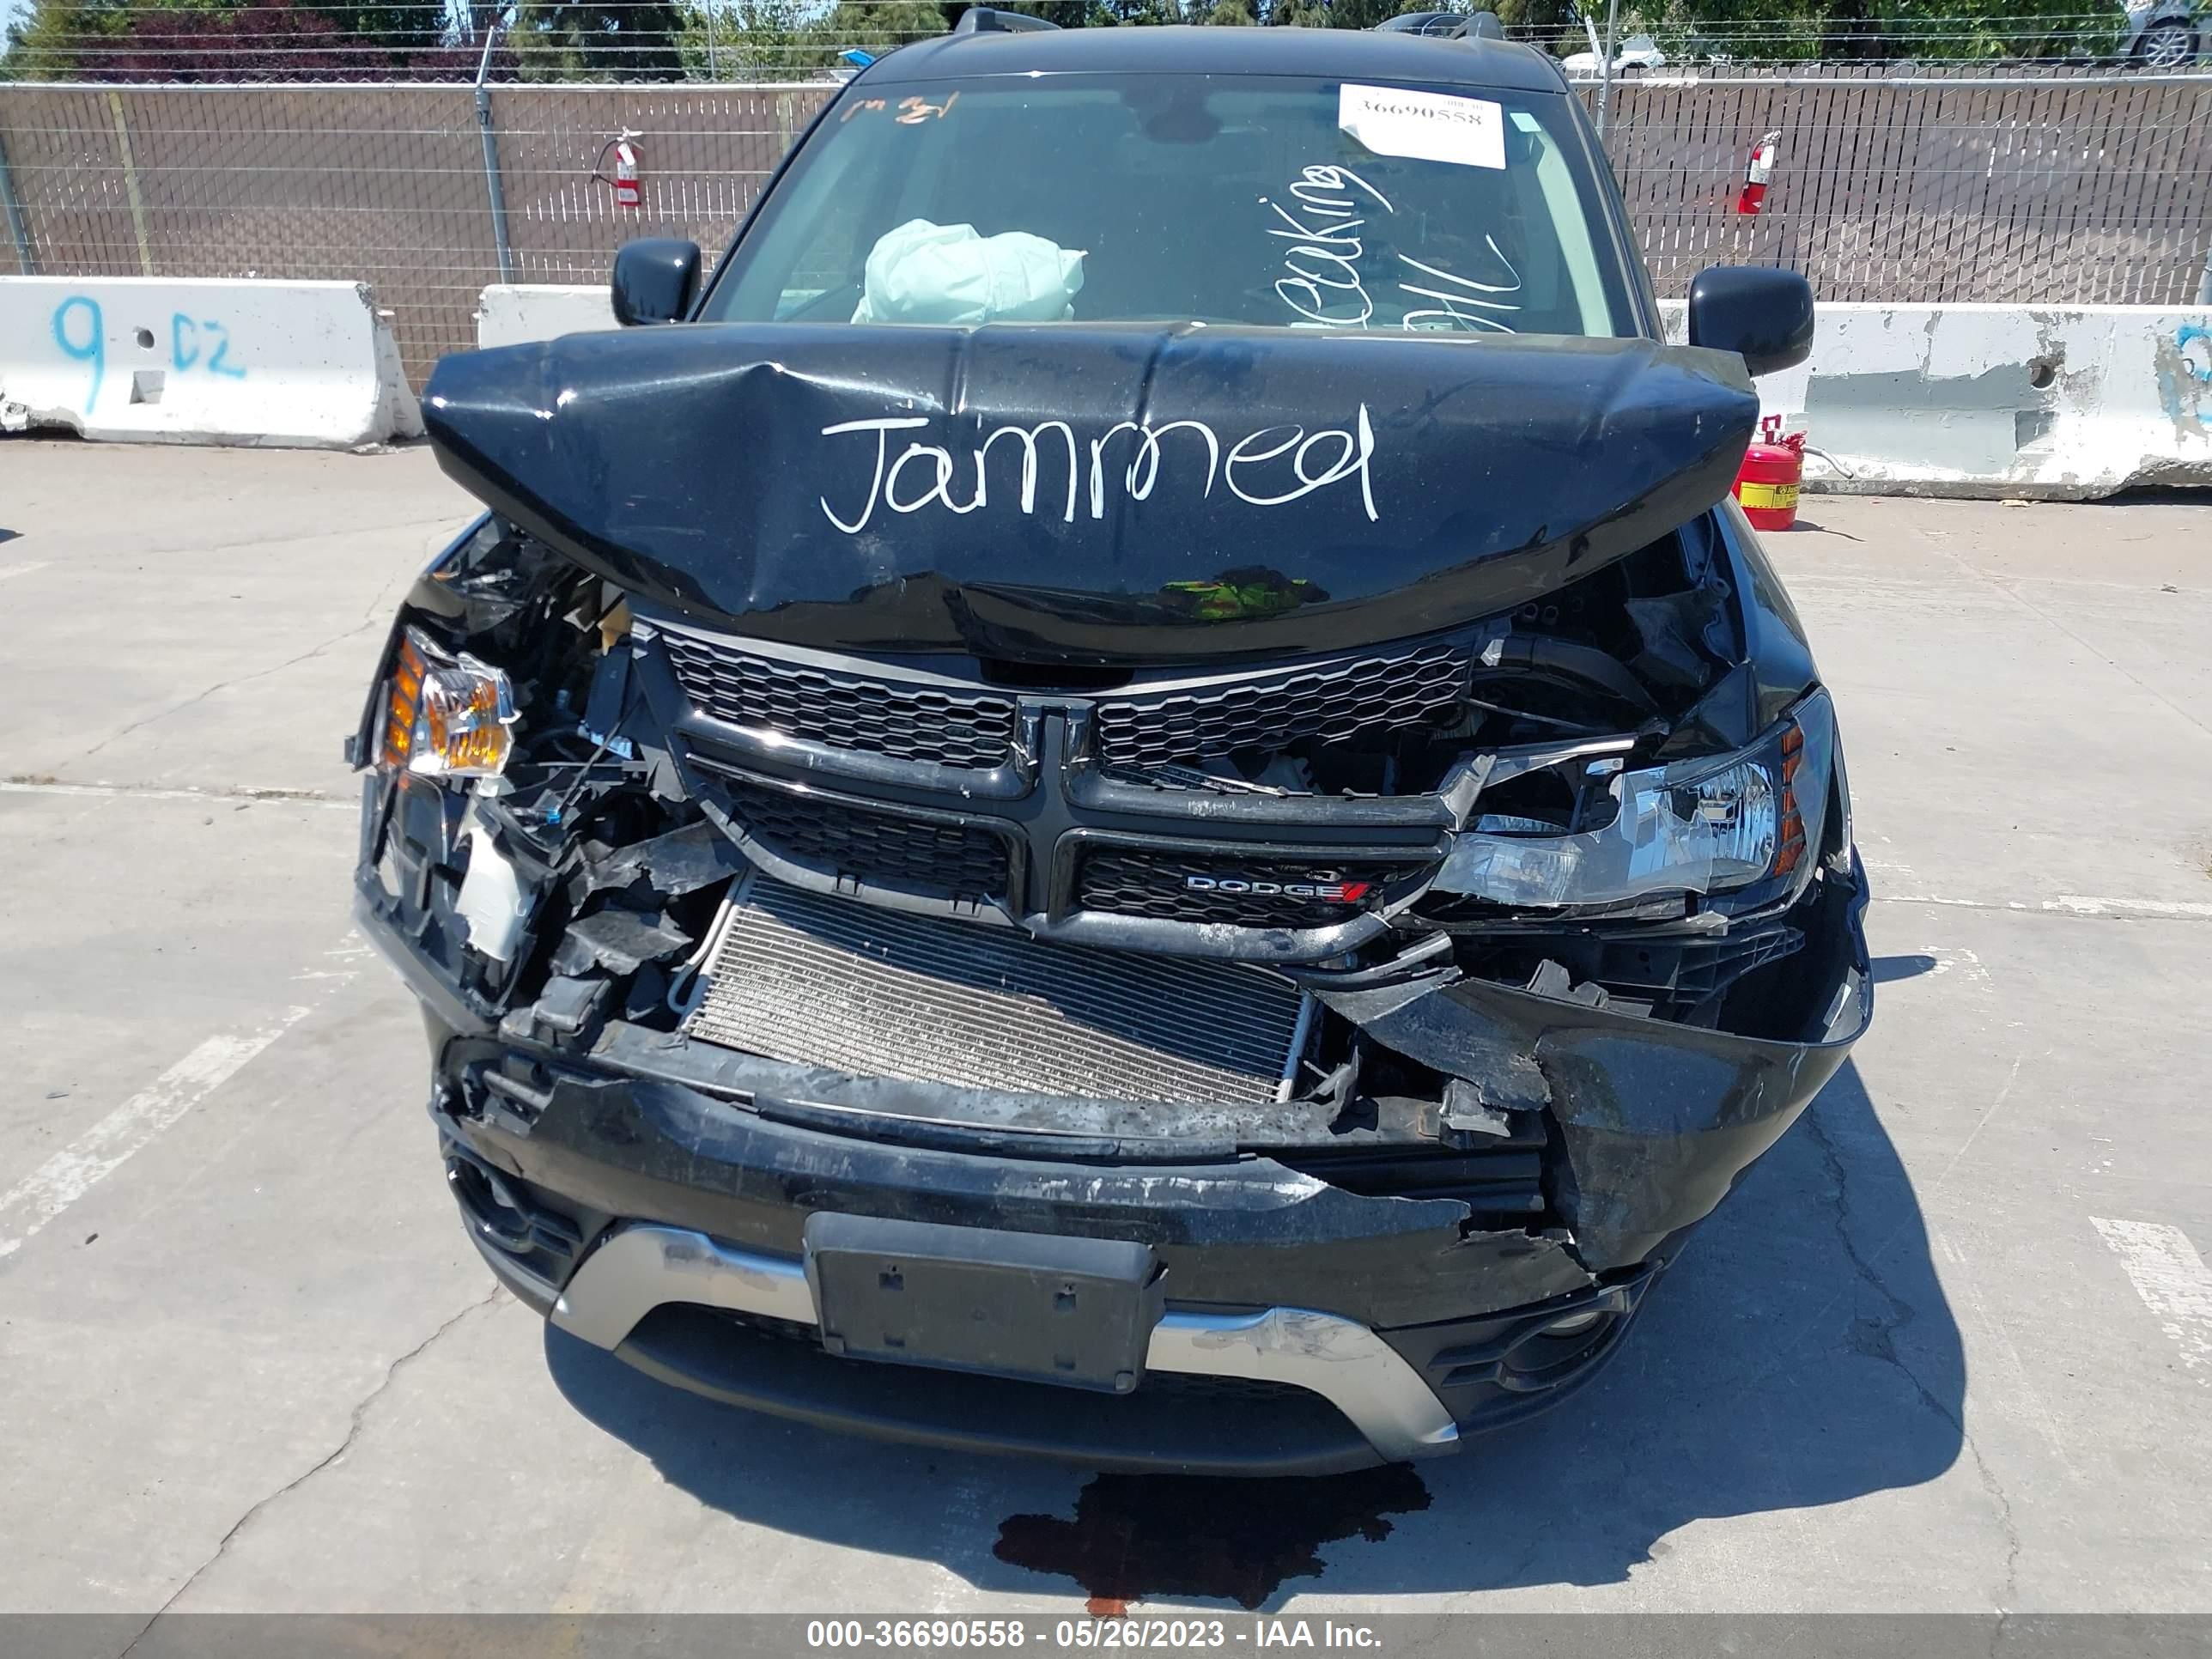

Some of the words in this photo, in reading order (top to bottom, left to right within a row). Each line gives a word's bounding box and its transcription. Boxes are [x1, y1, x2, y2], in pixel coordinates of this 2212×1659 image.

[1360, 99, 1482, 126] 36690558
[53, 295, 105, 414] 9
[820, 402, 1379, 534] Jammed
[1187, 876, 1345, 898] DODGE
